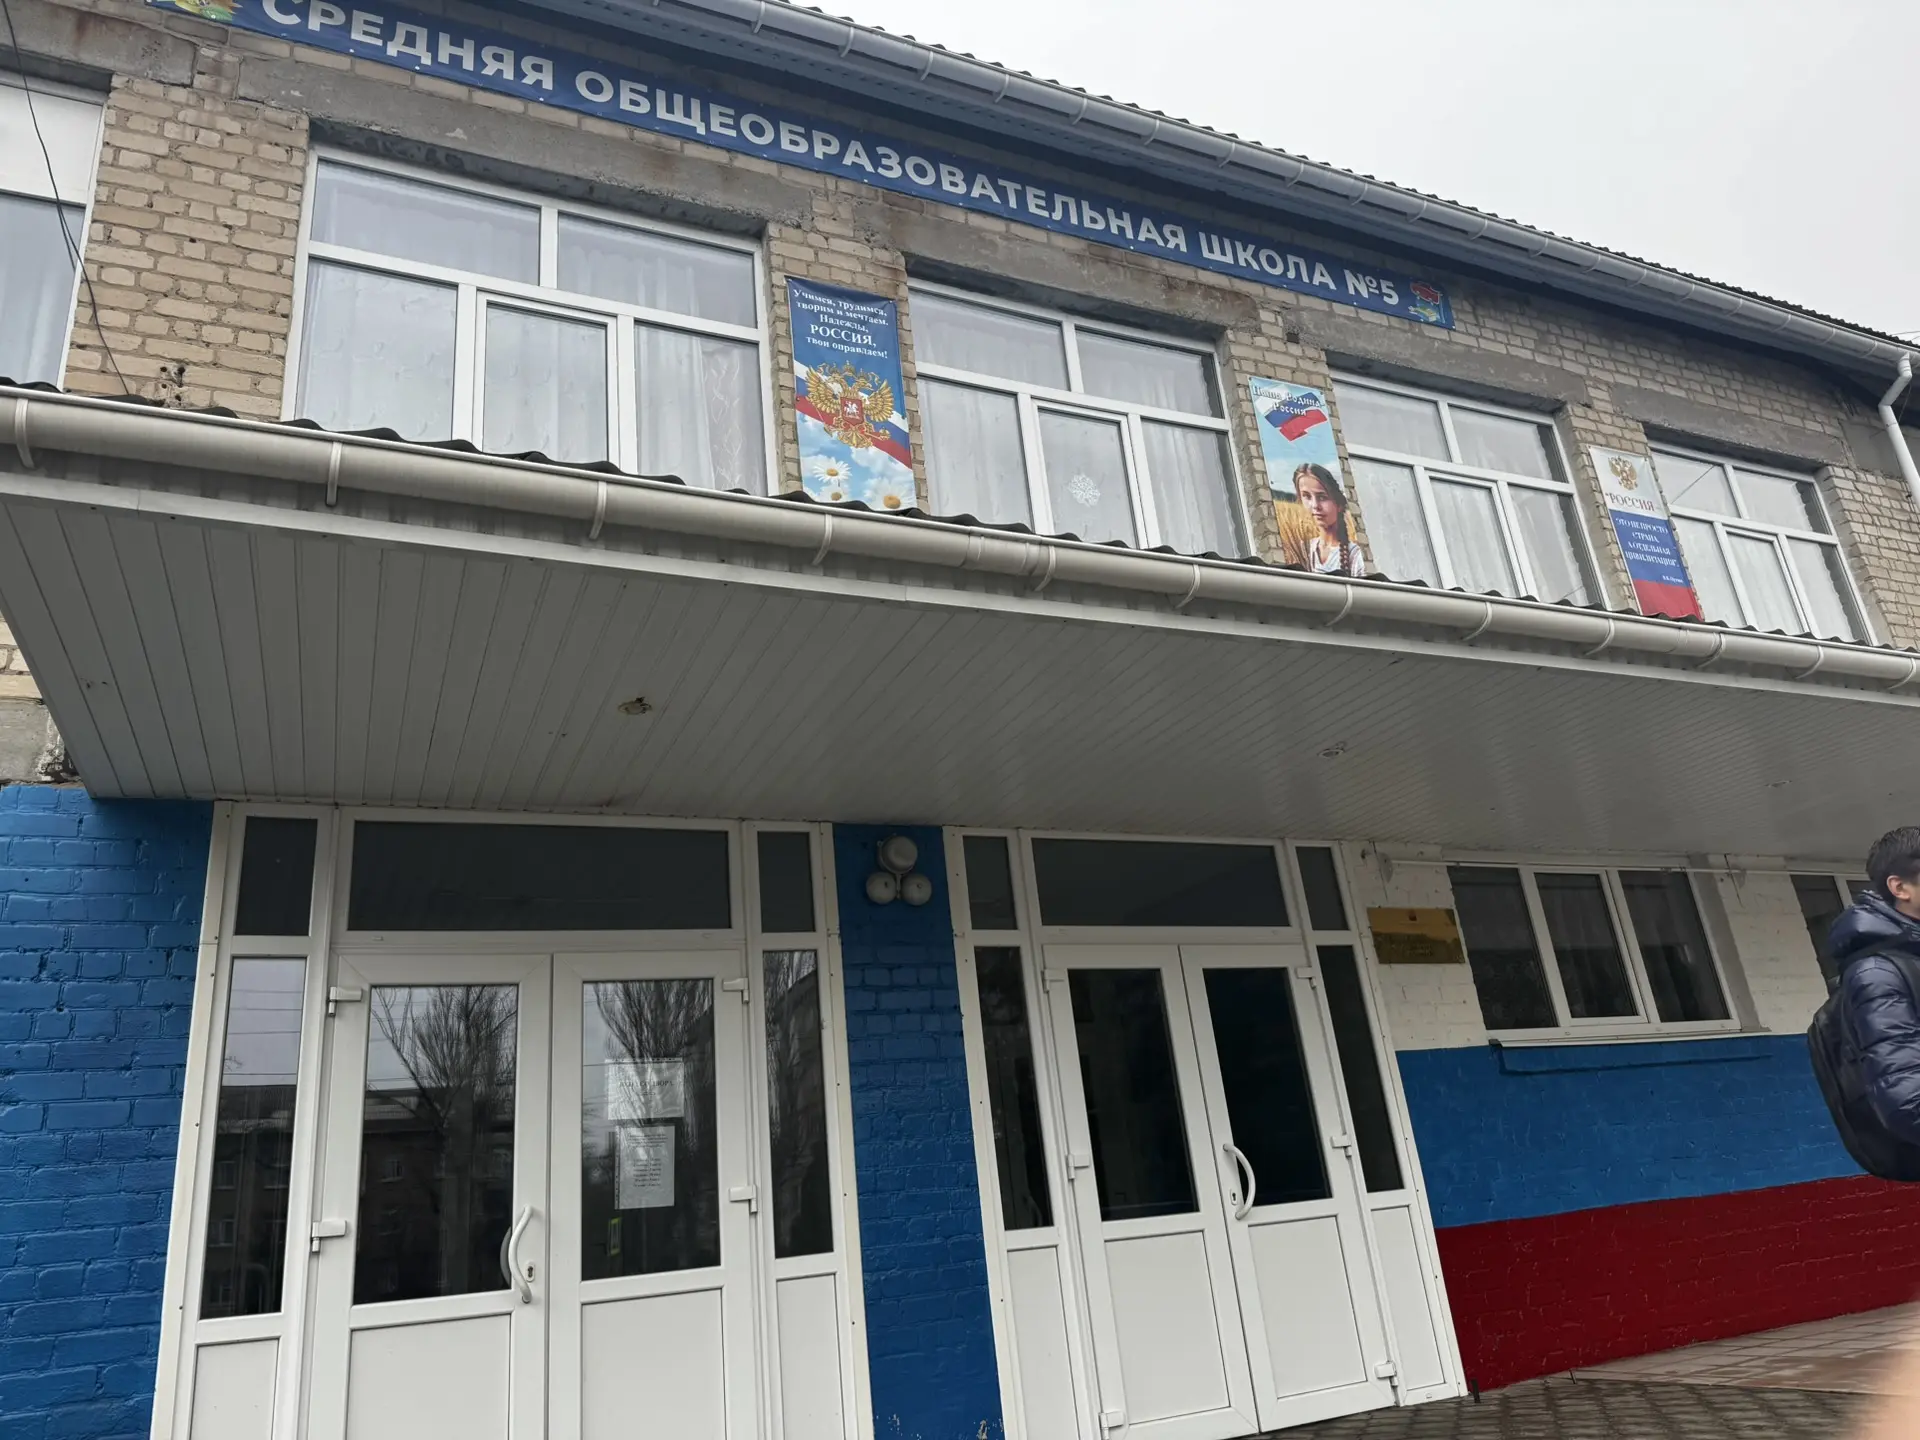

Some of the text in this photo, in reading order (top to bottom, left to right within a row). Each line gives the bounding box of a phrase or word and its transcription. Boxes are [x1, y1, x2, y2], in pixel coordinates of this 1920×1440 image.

[262, 0, 1399, 306] СРЕДНЯЯ ОБЩЕОБРАЗОВАТЕЛЬНАЯ ШКОЛА №5
[793, 289, 836, 306] Учимся,
[796, 302, 834, 314] творим
[845, 312, 889, 325] мечтаем.
[820, 314, 869, 333] Надежды,
[810, 324, 876, 347] РОССИЯ,
[805, 336, 888, 359] твои оправдаем!
[1253, 385, 1282, 400] Наша
[1273, 402, 1306, 416] Россия
[1616, 518, 1669, 534] ЭТО НЕ ПРОСТО
[1633, 543, 1671, 555] ОТДЕЛЬНАЯ
